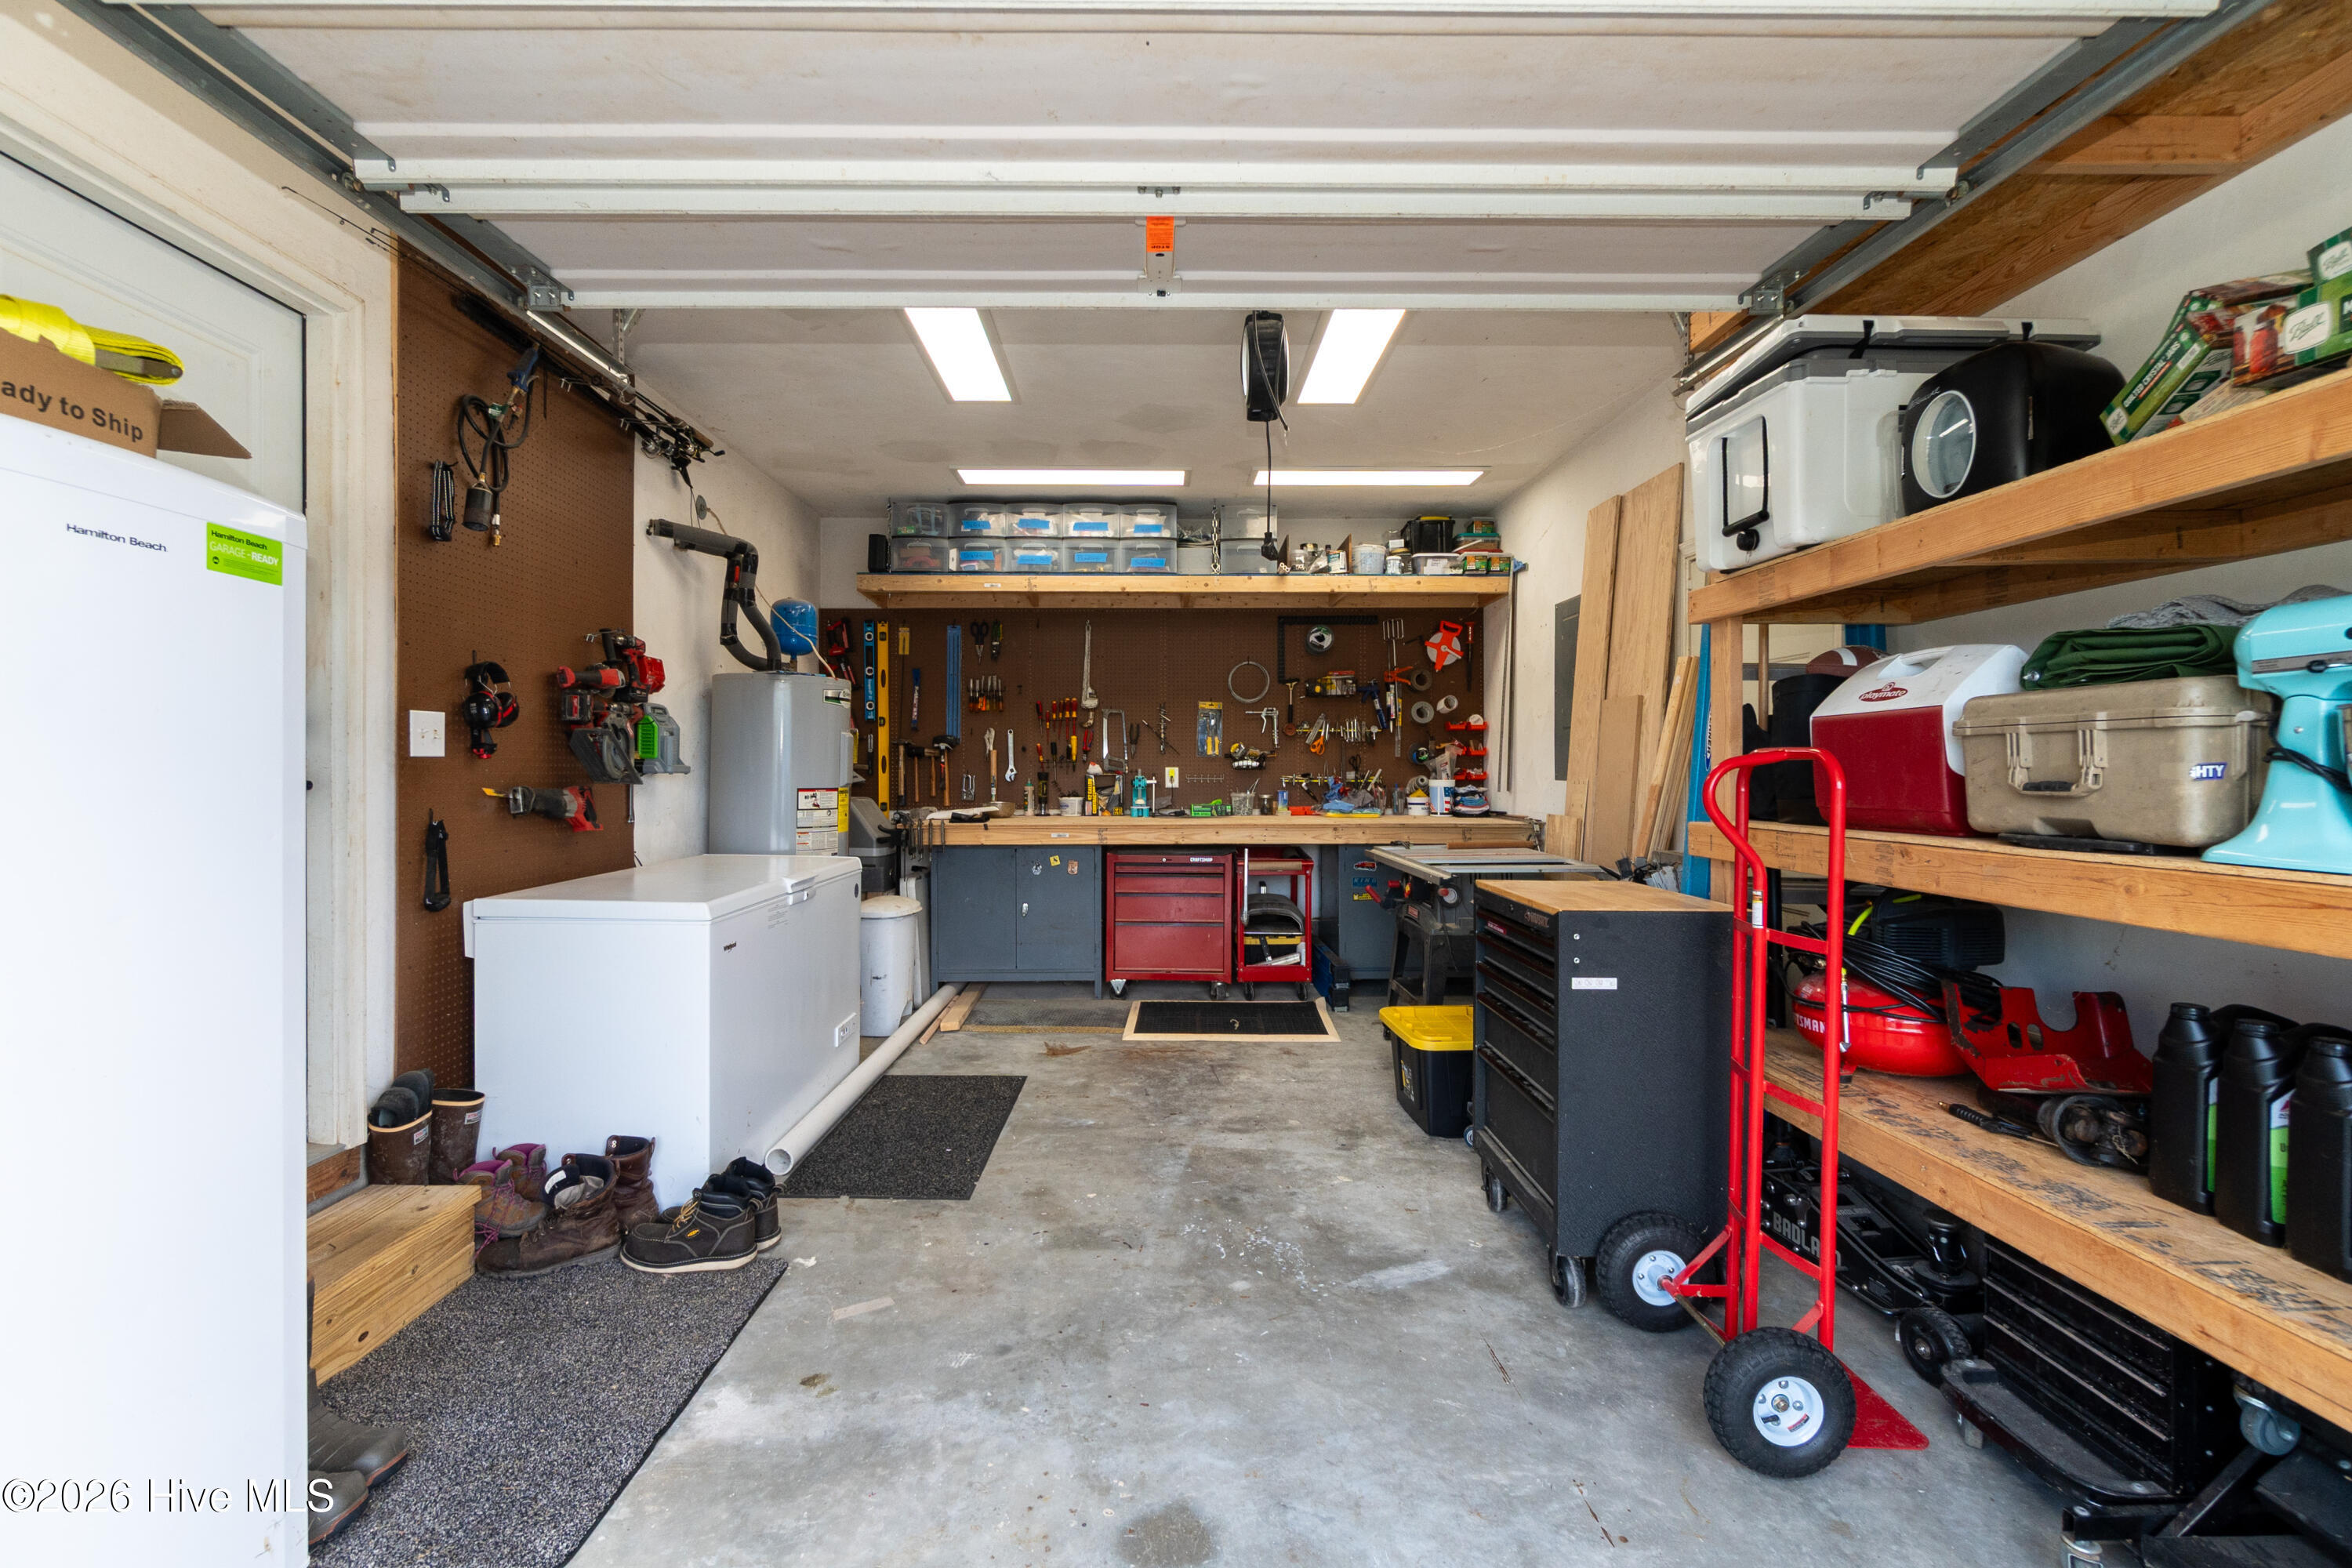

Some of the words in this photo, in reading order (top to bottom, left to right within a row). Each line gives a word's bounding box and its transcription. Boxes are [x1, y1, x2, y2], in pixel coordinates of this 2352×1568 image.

[60, 397, 85, 419] to
[92, 408, 143, 442] Ship
[67, 523, 125, 543] Hamilton
[129, 536, 167, 552] Beach
[211, 530, 245, 544] Hamilton
[246, 539, 268, 550] Beach
[1860, 690, 1907, 700] playmate
